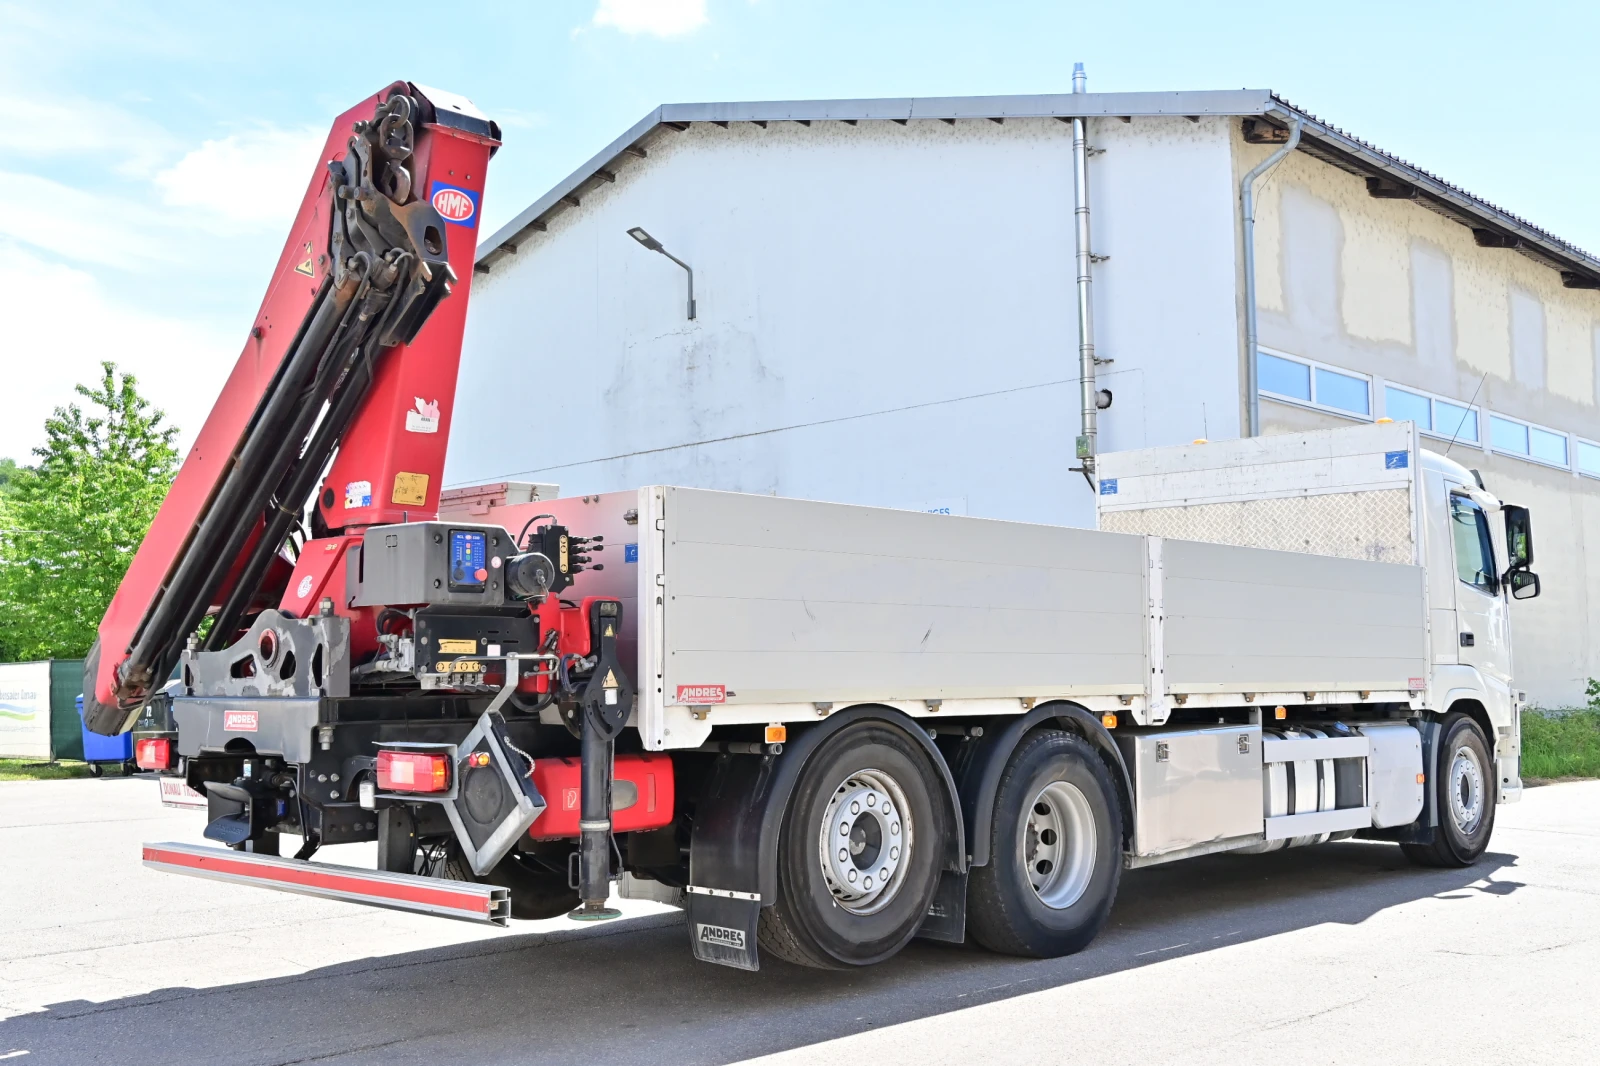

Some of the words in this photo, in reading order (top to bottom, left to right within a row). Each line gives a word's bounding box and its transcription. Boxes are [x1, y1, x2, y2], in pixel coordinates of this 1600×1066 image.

[438, 193, 469, 217] HMF
[680, 687, 724, 701] ANDRES
[146, 705, 152, 717] 72
[226, 714, 257, 728] ANDRES
[700, 926, 744, 947] ANDRES
